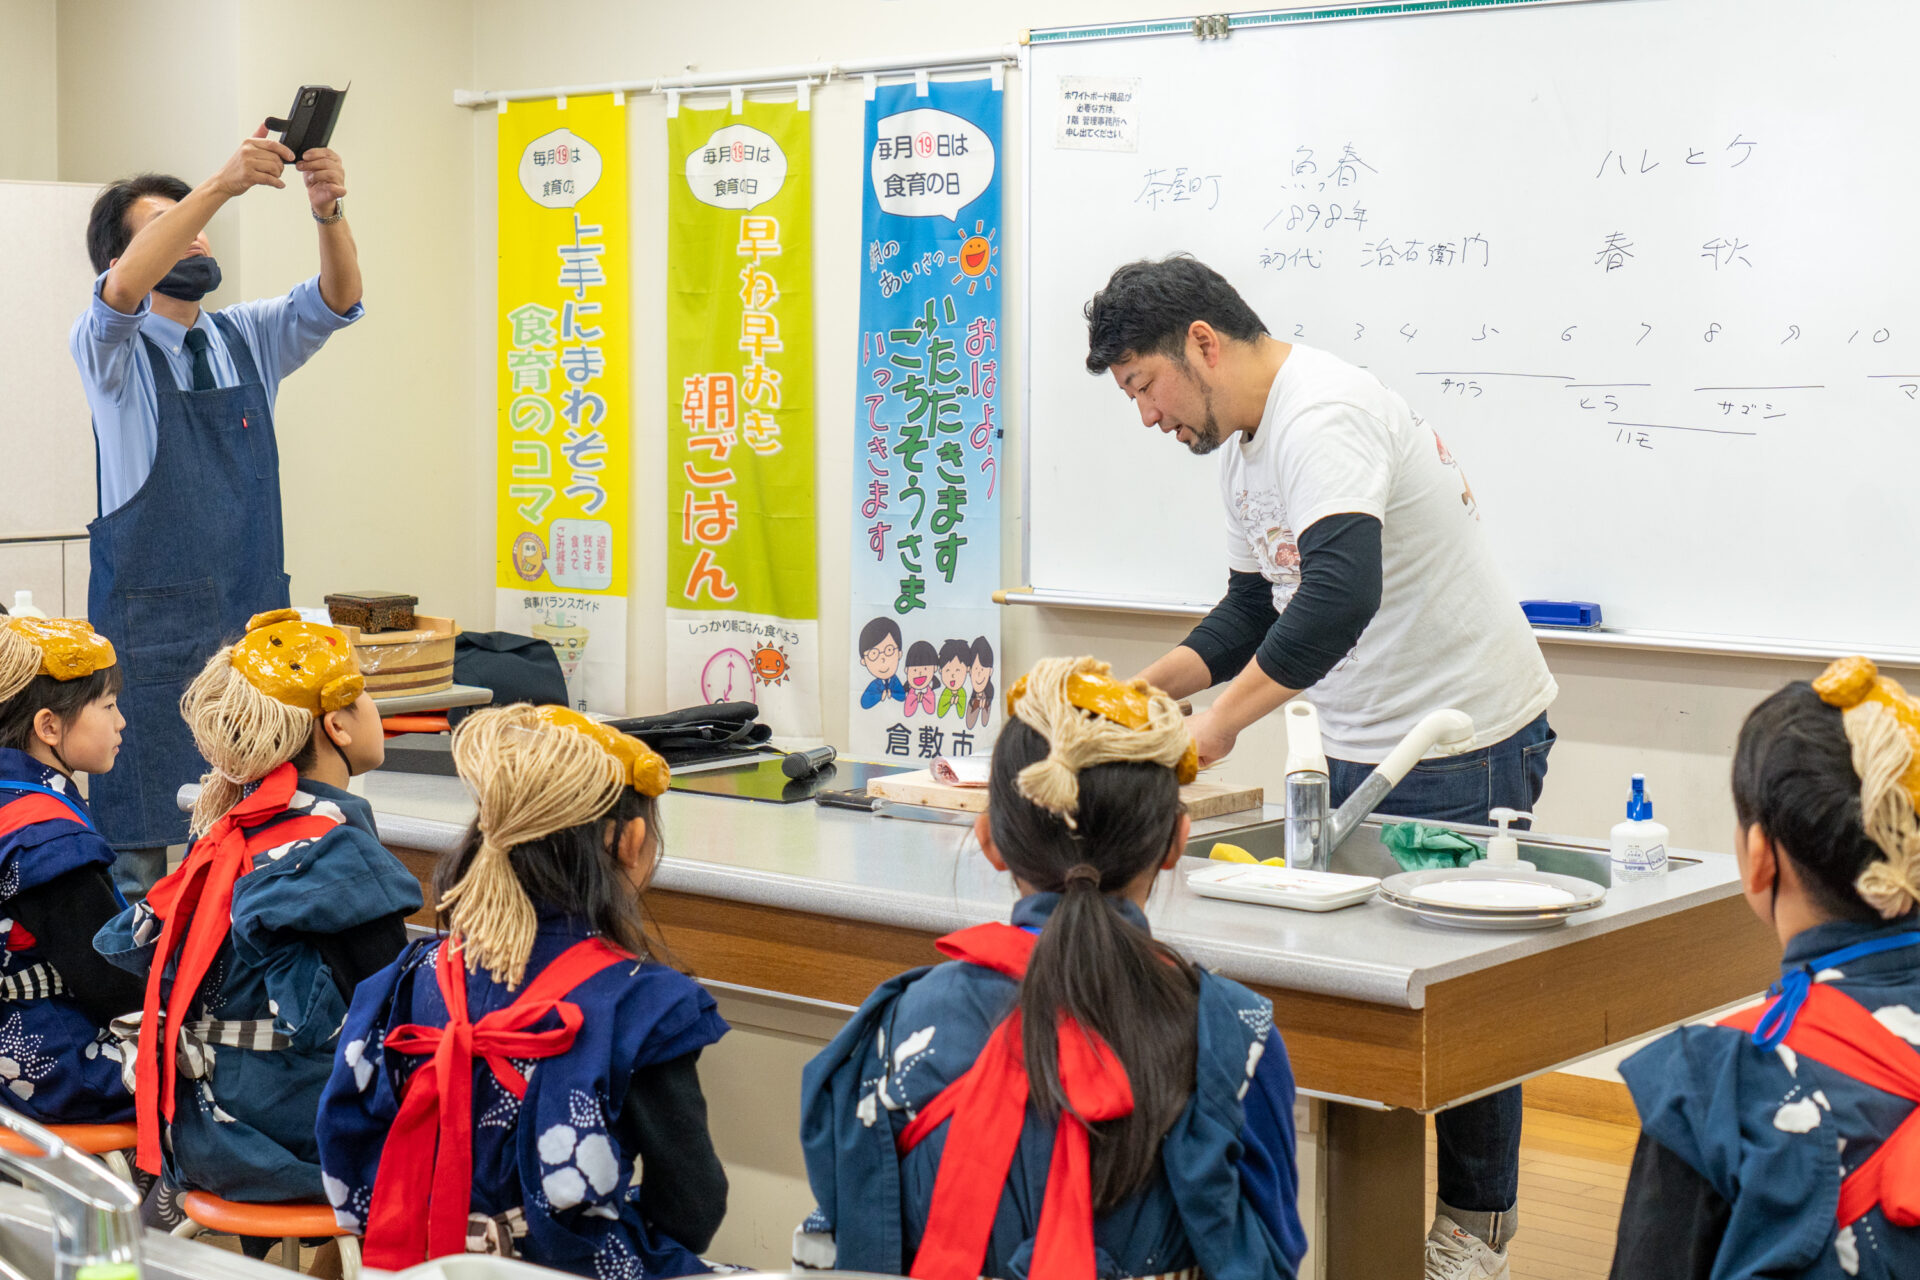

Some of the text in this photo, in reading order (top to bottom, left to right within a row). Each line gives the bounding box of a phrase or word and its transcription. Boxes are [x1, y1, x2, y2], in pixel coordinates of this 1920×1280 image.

[1064, 91, 1132, 102] ホワイトボード用品が
[883, 172, 960, 198] 食育の日
[1133, 167, 1222, 211] 茶屋町
[1263, 200, 1368, 233] 1898年
[1259, 248, 1322, 270] 初代
[1594, 231, 1753, 273] 春 秋
[737, 216, 782, 454] 早ね早おき
[1293, 324, 1305, 337] 2
[1353, 323, 1365, 340] 3
[1399, 323, 1418, 342] 4
[1561, 325, 1577, 341] 6
[1636, 322, 1652, 346] 7
[1704, 323, 1721, 342] 8
[558, 214, 606, 513] 上手にまわそう
[508, 303, 556, 523] 食育のコマ
[965, 317, 997, 500] おはよう
[861, 332, 892, 562] いってきます
[924, 295, 969, 583] いただきます
[1616, 429, 1653, 449] ハモ
[683, 373, 737, 600] 朝ごはん
[889, 318, 931, 615] ごちそうさま
[523, 596, 600, 613] 食事バランスガイド
[885, 723, 975, 759] 倉敷市
